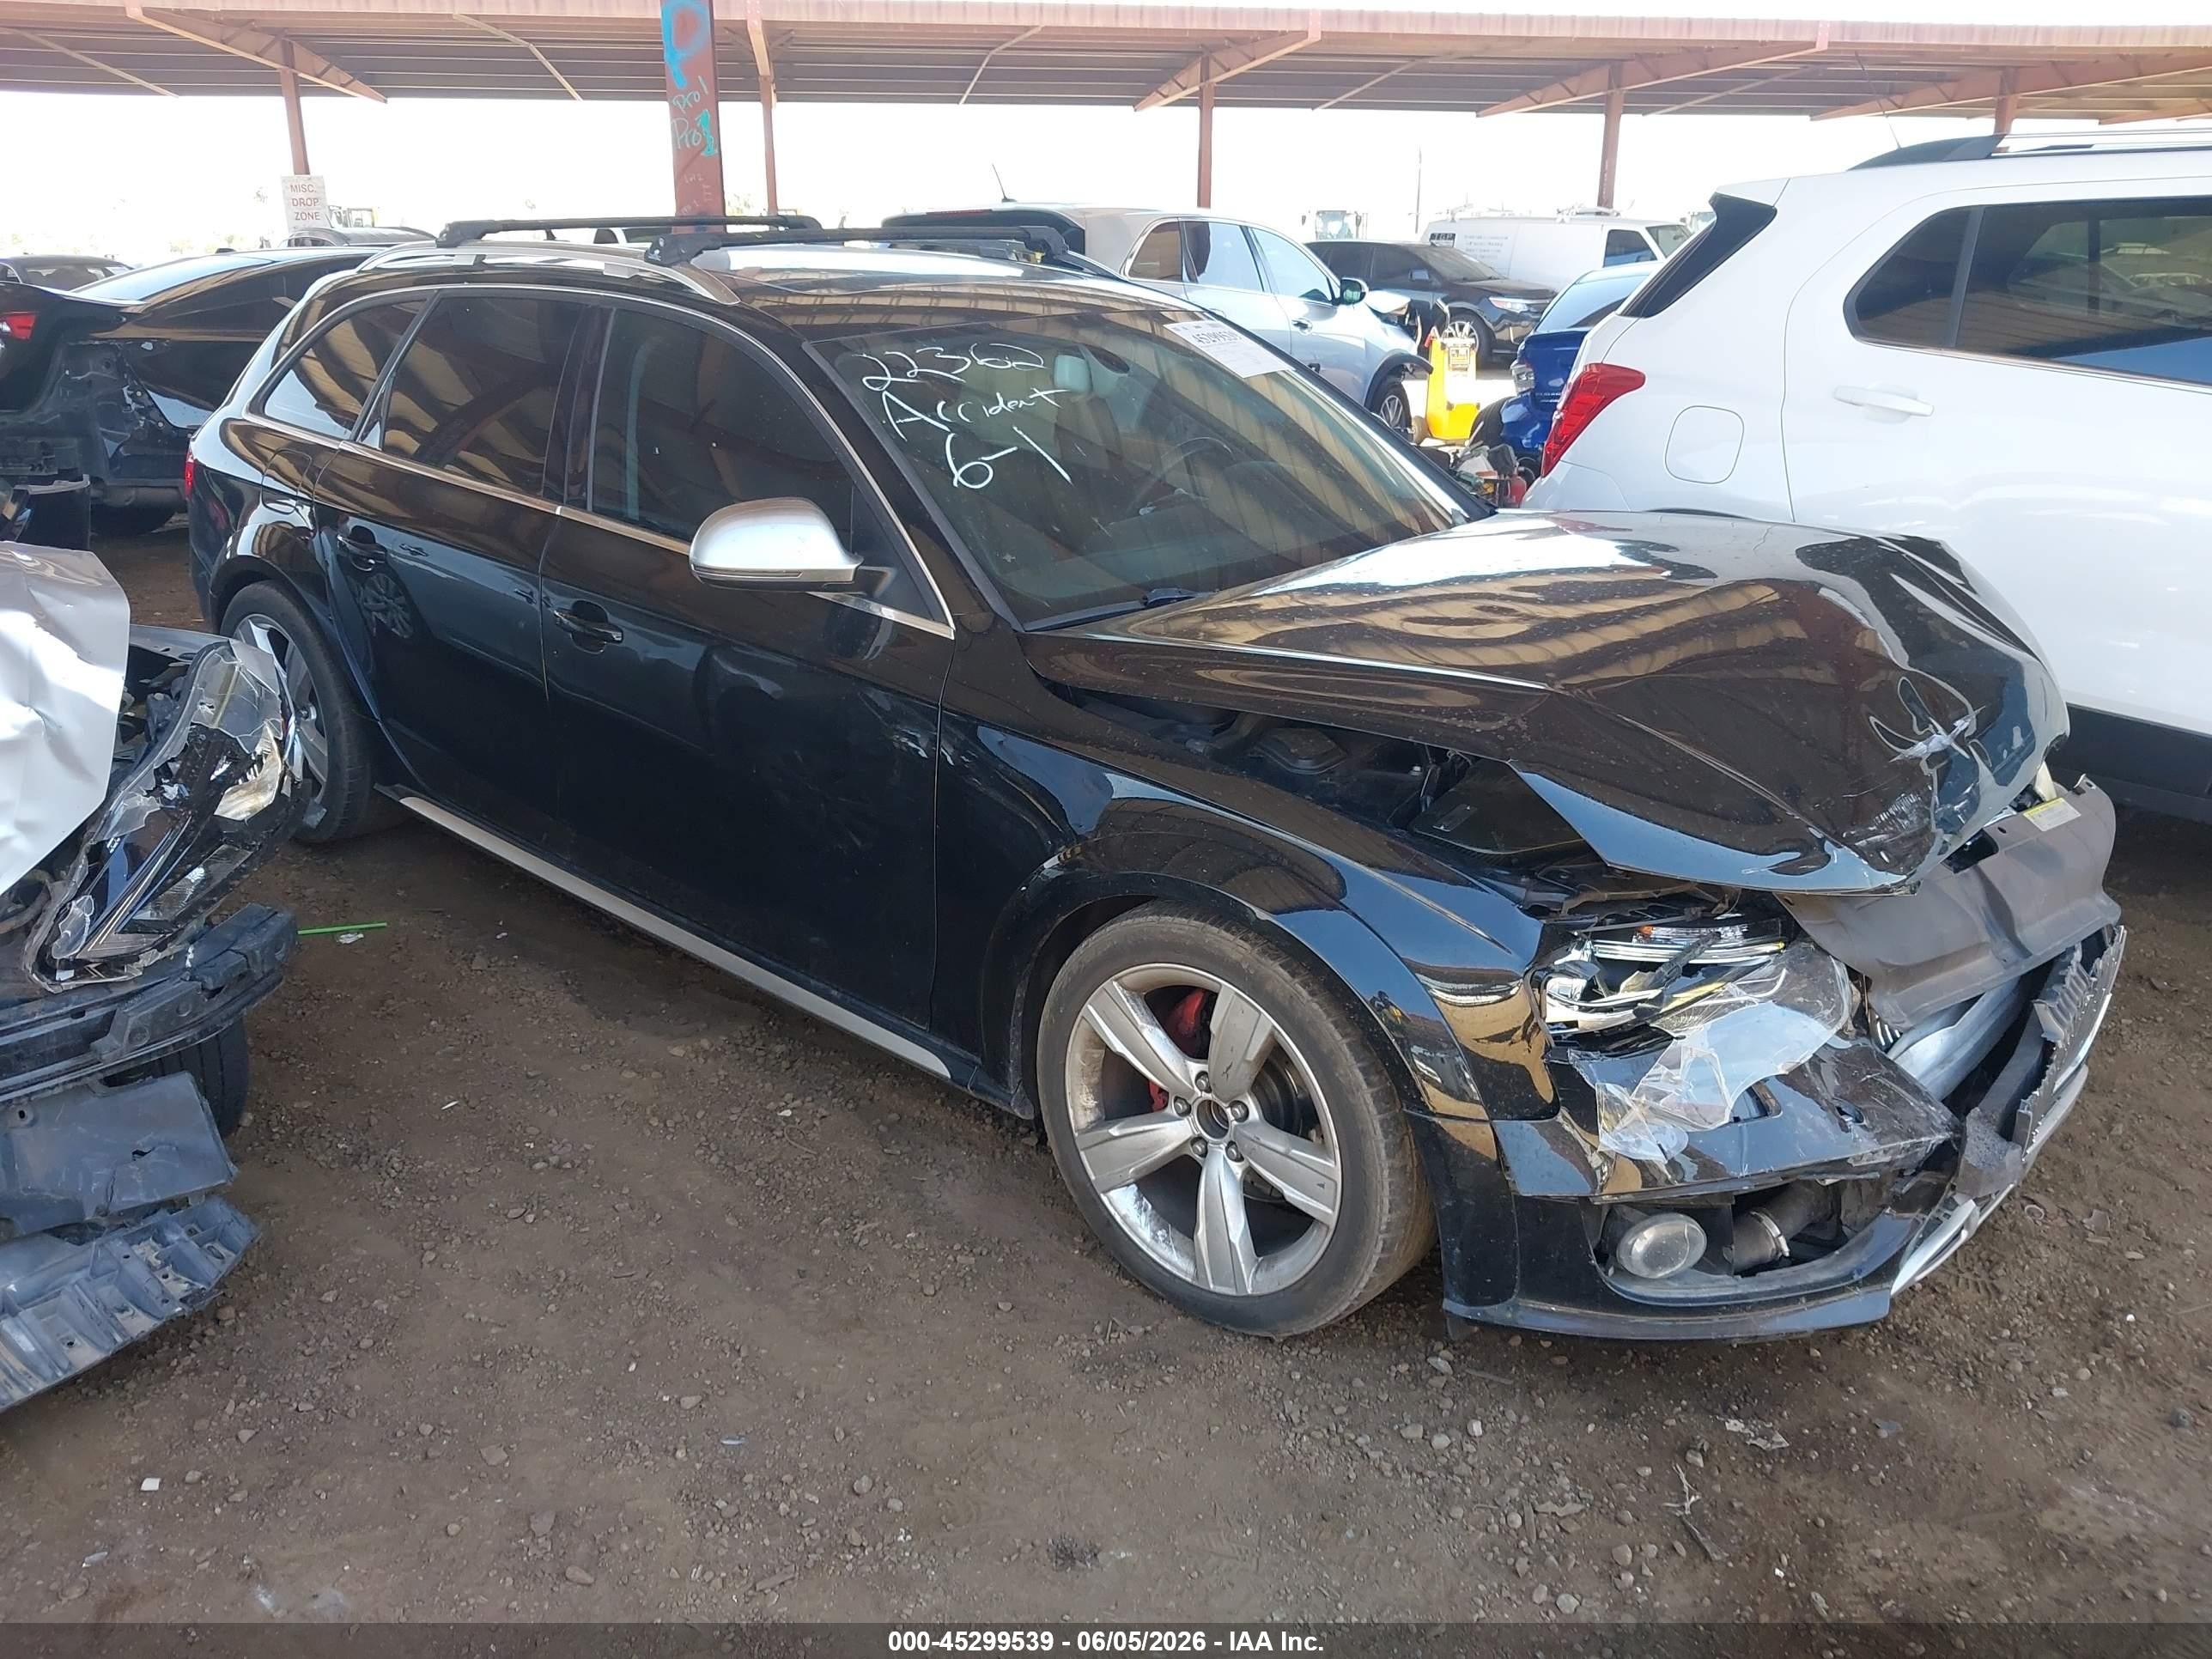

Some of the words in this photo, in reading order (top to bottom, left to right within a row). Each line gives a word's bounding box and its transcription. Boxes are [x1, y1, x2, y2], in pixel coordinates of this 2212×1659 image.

[290, 184, 317, 193] MISC.
[292, 198, 319, 207] DROP
[295, 211, 321, 221] ZONE
[881, 386, 1072, 442] Accident
